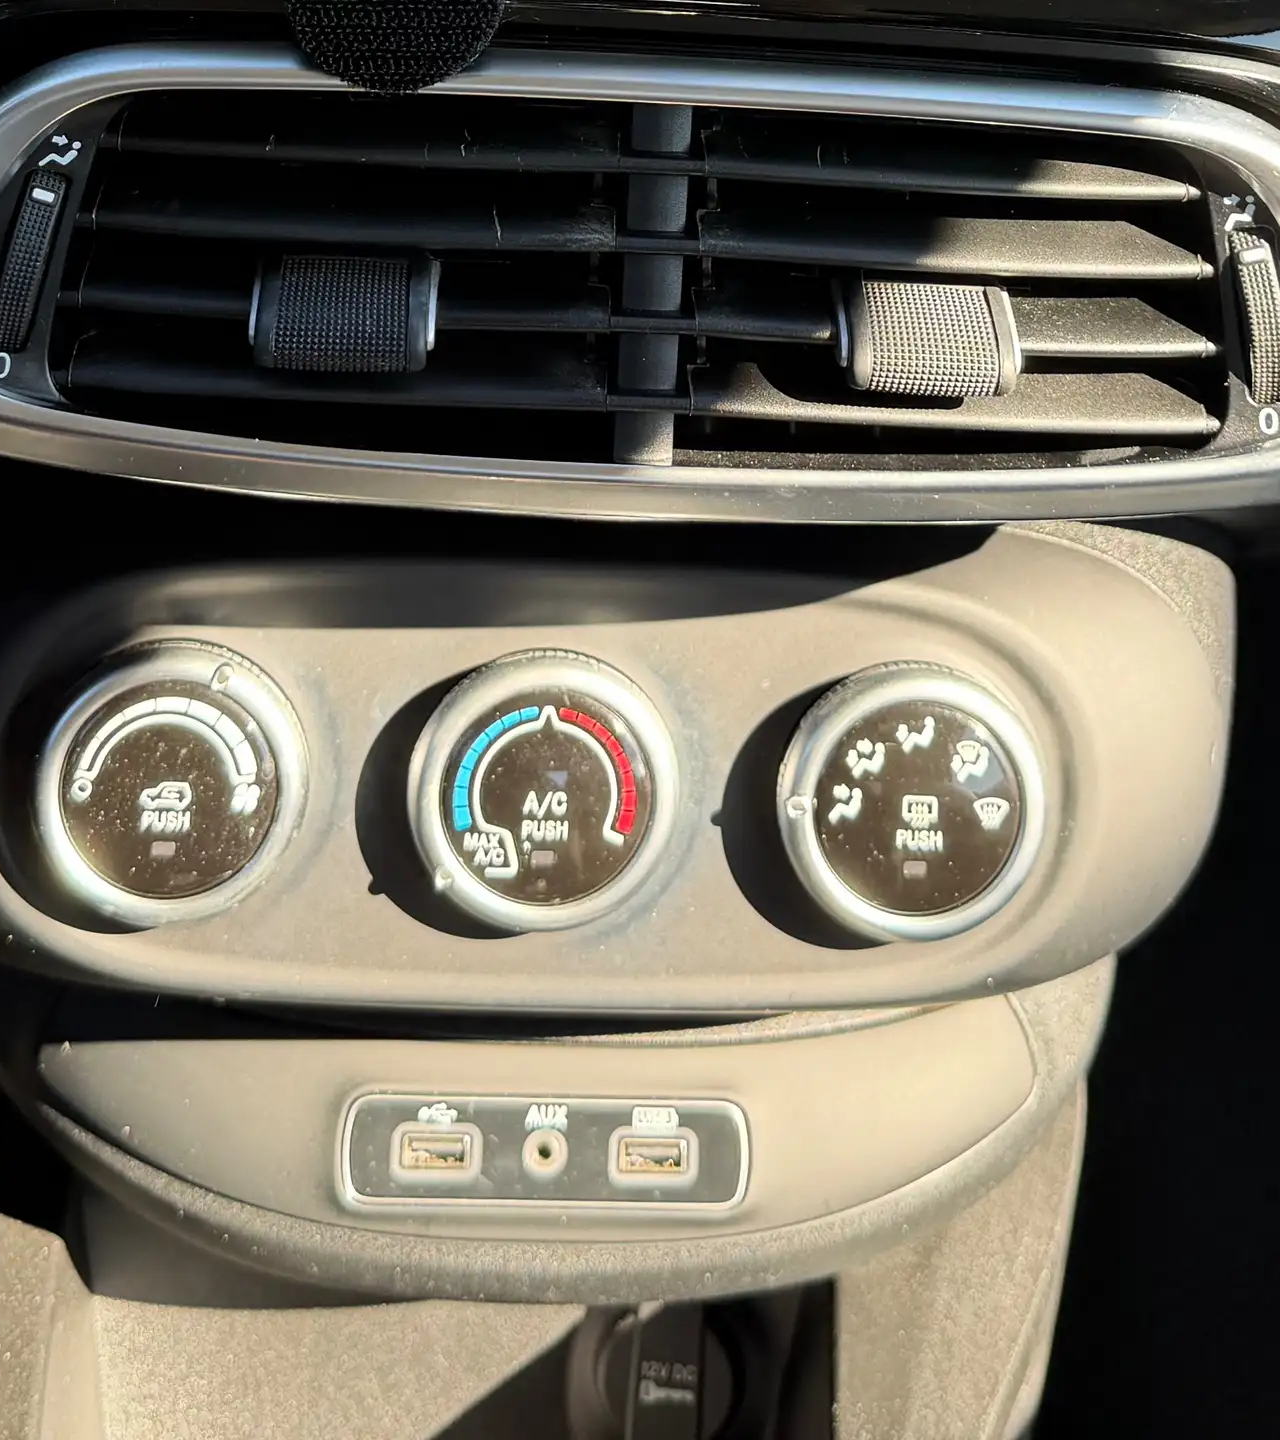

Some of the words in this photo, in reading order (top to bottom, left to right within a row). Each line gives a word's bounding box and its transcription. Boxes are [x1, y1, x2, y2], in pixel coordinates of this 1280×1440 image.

[522, 789, 568, 820] A/C
[140, 810, 191, 834] PUSH
[521, 818, 569, 843] PUSH
[463, 831, 501, 852] MAX
[895, 827, 944, 853] PUSH
[472, 846, 506, 867] A/C
[524, 1103, 568, 1131] AUX
